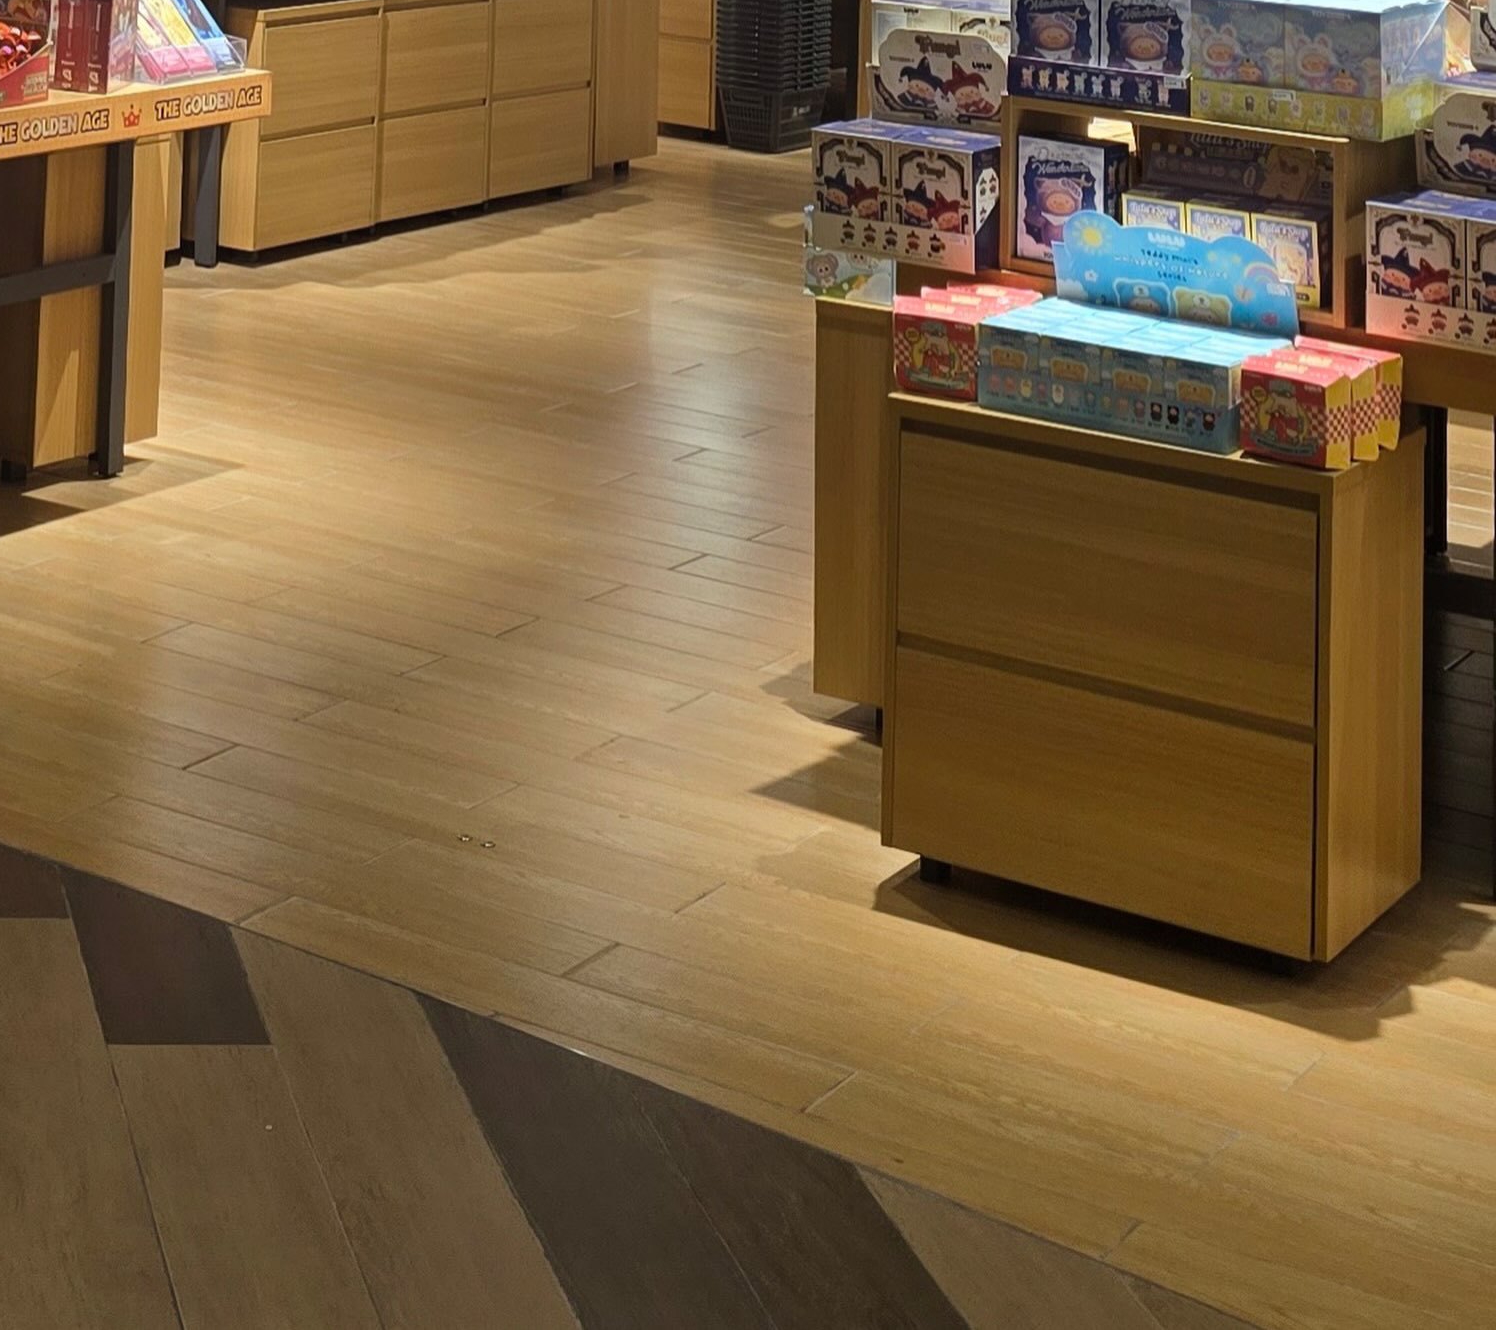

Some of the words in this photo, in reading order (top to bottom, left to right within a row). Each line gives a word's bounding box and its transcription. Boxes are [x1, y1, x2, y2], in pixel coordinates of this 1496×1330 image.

[971, 61, 993, 71] LULU
[155, 97, 181, 120] THE
[183, 91, 235, 116] GOLDEN
[236, 85, 263, 108] AGE
[20, 113, 80, 142] GOLDEN
[81, 109, 111, 130] AGE
